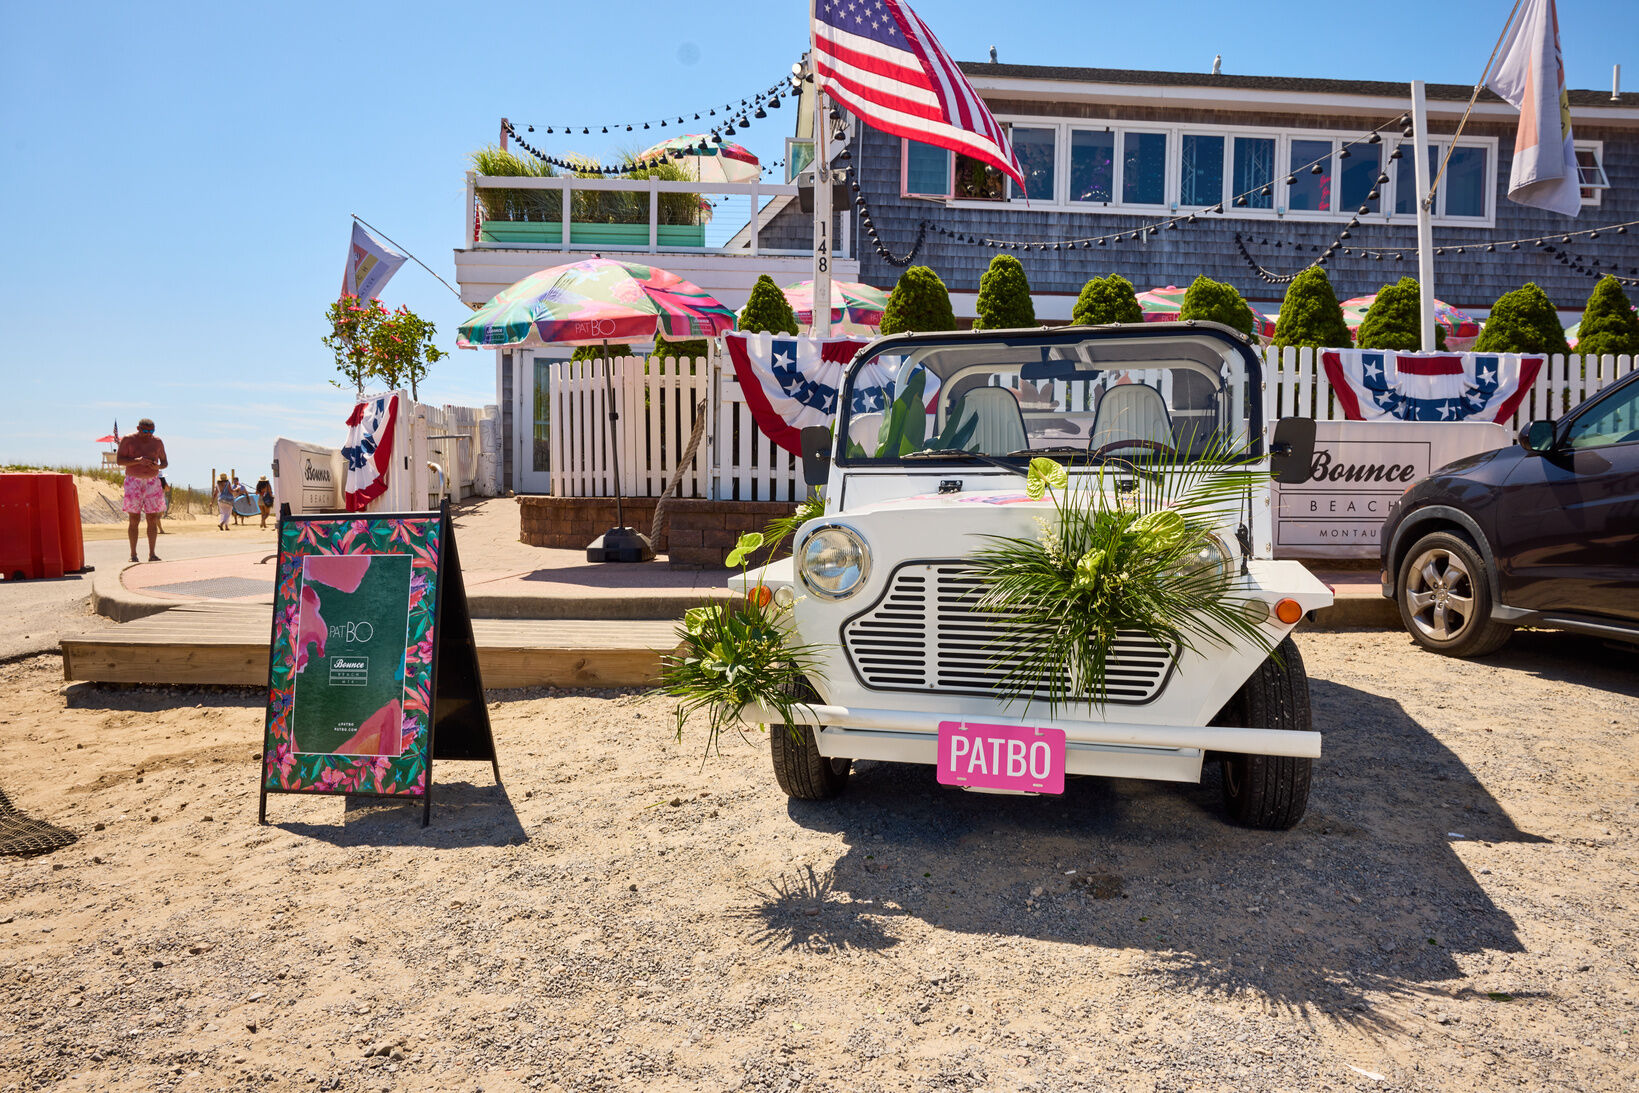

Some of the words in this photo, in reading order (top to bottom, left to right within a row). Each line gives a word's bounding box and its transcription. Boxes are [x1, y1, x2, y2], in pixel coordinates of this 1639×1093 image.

[818, 221, 827, 272] 148
[575, 319, 616, 336] PATBO
[305, 458, 331, 482] Bounce
[1309, 449, 1415, 482] Bounce
[1319, 529, 1377, 538] MONTAU
[329, 621, 374, 643] PATBO
[333, 658, 365, 669] Bounce
[950, 735, 1051, 779] PATBO
